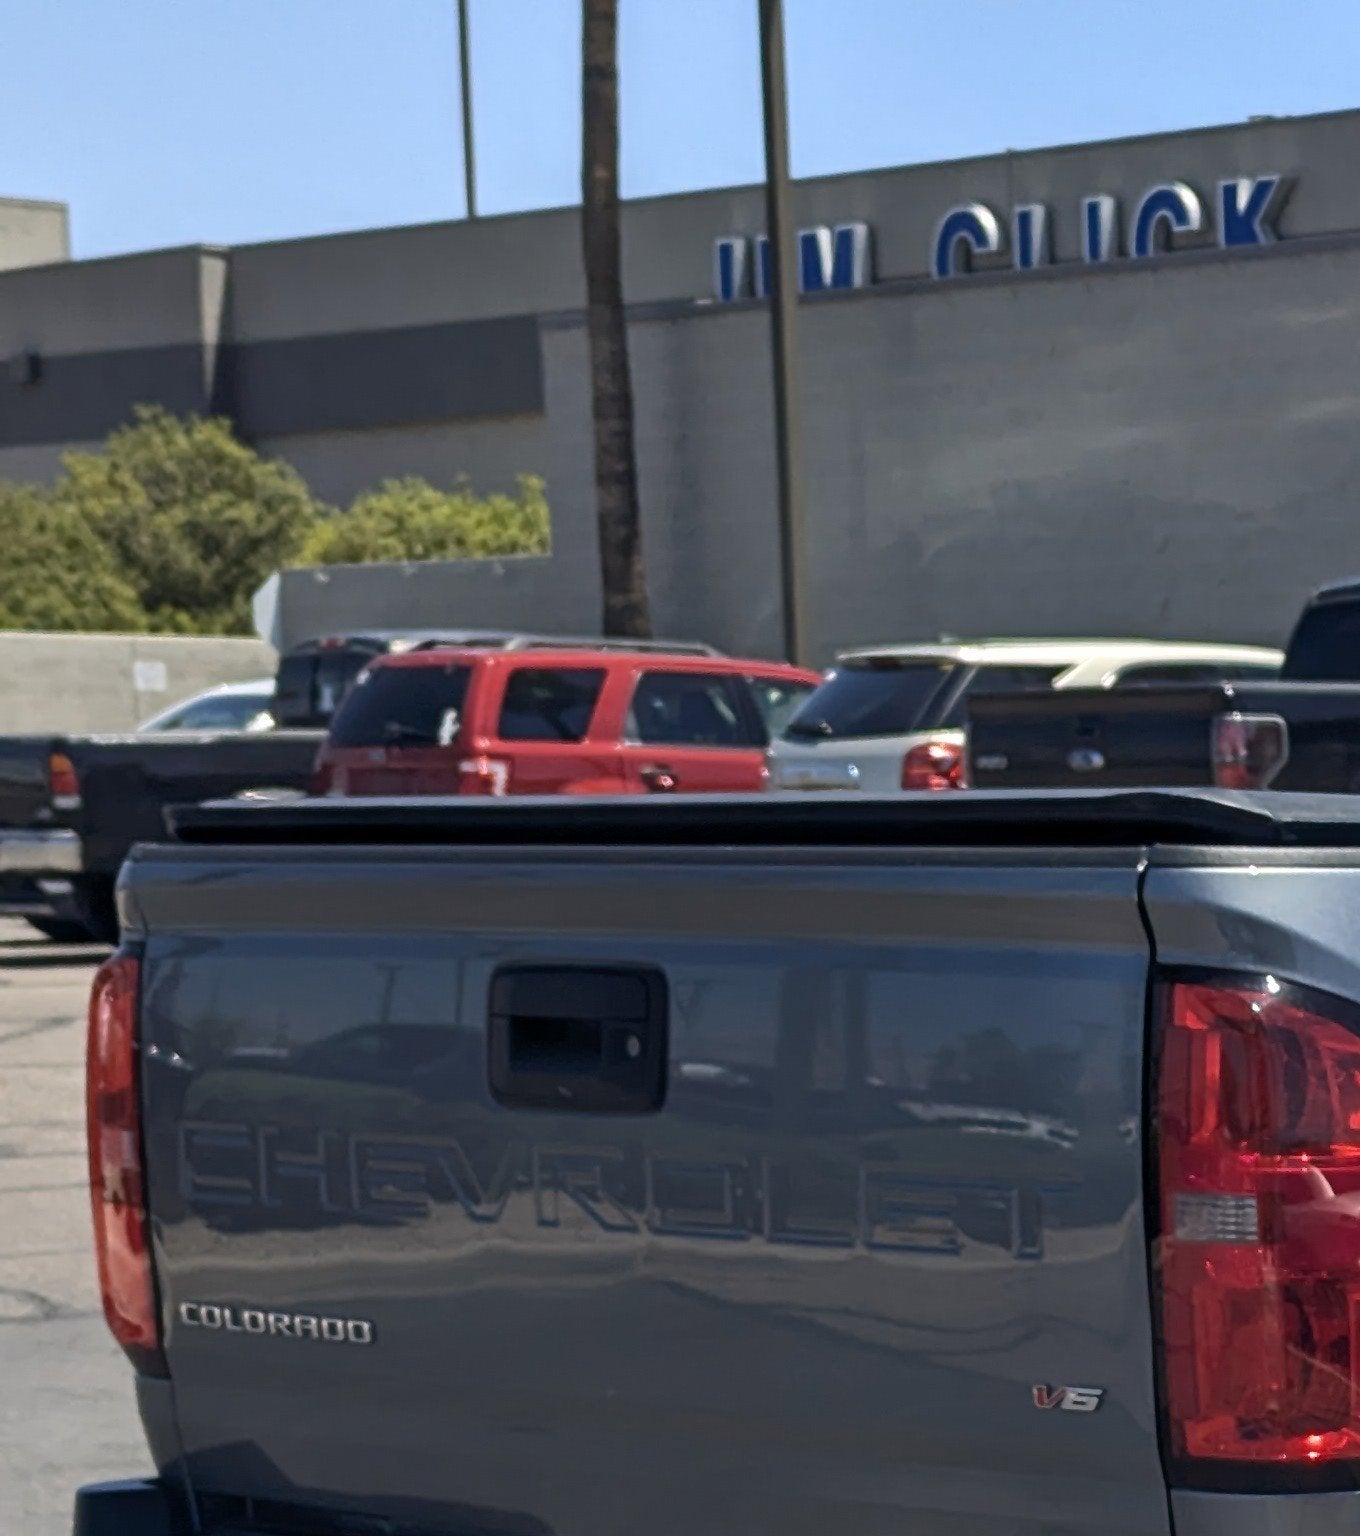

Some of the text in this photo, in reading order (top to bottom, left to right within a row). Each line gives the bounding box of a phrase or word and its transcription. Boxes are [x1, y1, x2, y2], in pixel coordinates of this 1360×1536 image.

[176, 1120, 1085, 1262] CHEVROLET
[178, 1300, 378, 1345] COLORADO
[1031, 1384, 1106, 1412] V6
